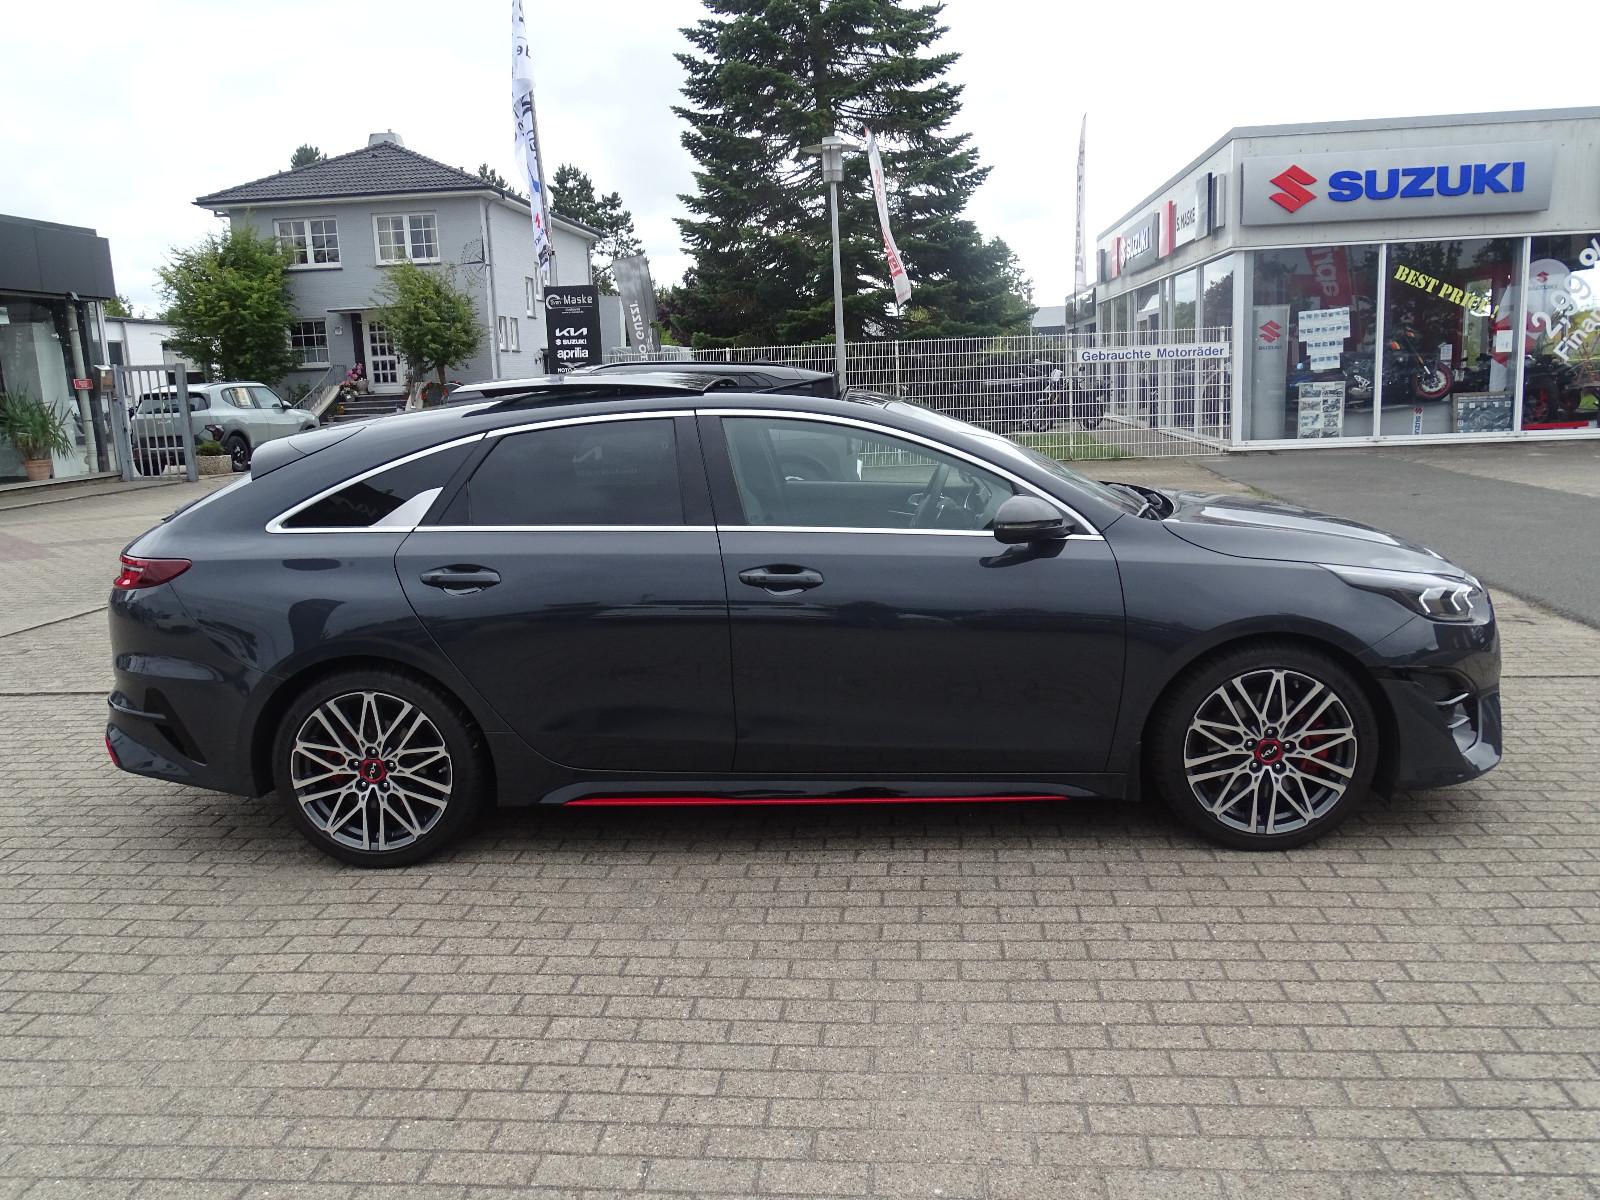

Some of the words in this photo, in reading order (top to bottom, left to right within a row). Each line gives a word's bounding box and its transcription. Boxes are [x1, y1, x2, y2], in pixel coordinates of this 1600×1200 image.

[1328, 161, 1525, 202] SUZUKI
[1127, 227, 1150, 260] SUZUKI
[563, 293, 593, 305] Maske
[1393, 264, 1440, 293] BEST
[1438, 282, 1490, 313] PRICE
[557, 347, 589, 360] aprilia
[1081, 350, 1151, 362] Gebrauchte
[1156, 346, 1225, 359] Motorräder
